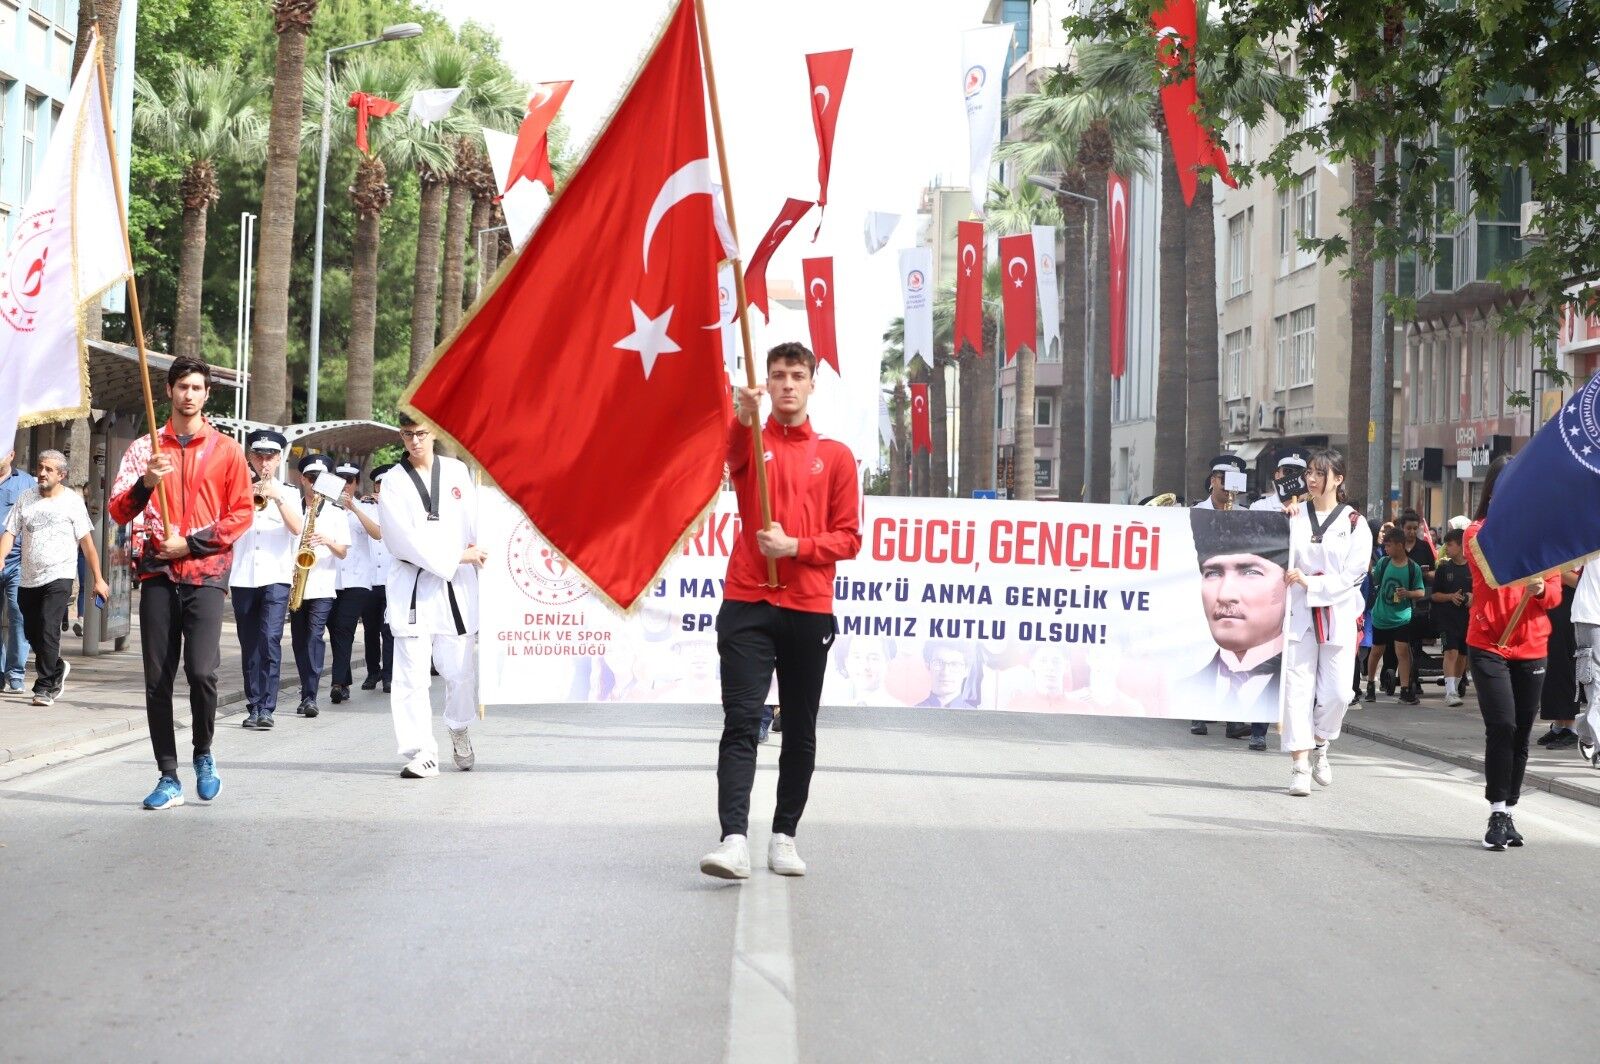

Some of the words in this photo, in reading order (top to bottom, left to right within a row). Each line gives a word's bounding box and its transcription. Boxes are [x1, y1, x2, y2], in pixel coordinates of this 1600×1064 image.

[682, 512, 742, 557] RKİ
[872, 517, 980, 573] GÜCÜ,
[988, 519, 1161, 572] GENÇLİĞİ
[834, 576, 909, 602] ÜRK'Ü
[921, 583, 993, 605] ANMA
[1005, 584, 1108, 615] GENÇLİK
[1120, 590, 1150, 611] VE
[524, 611, 584, 626] DENİZLİ
[682, 613, 713, 632] SP
[929, 618, 1006, 640] KUTLU
[1018, 621, 1107, 644] OLSUN!
[497, 629, 551, 643] GENÇLİK
[556, 630, 572, 641] VE
[577, 630, 612, 641] SPOR
[507, 643, 518, 656] İL
[523, 643, 606, 656] MÜDÜRLÜĞÜ
